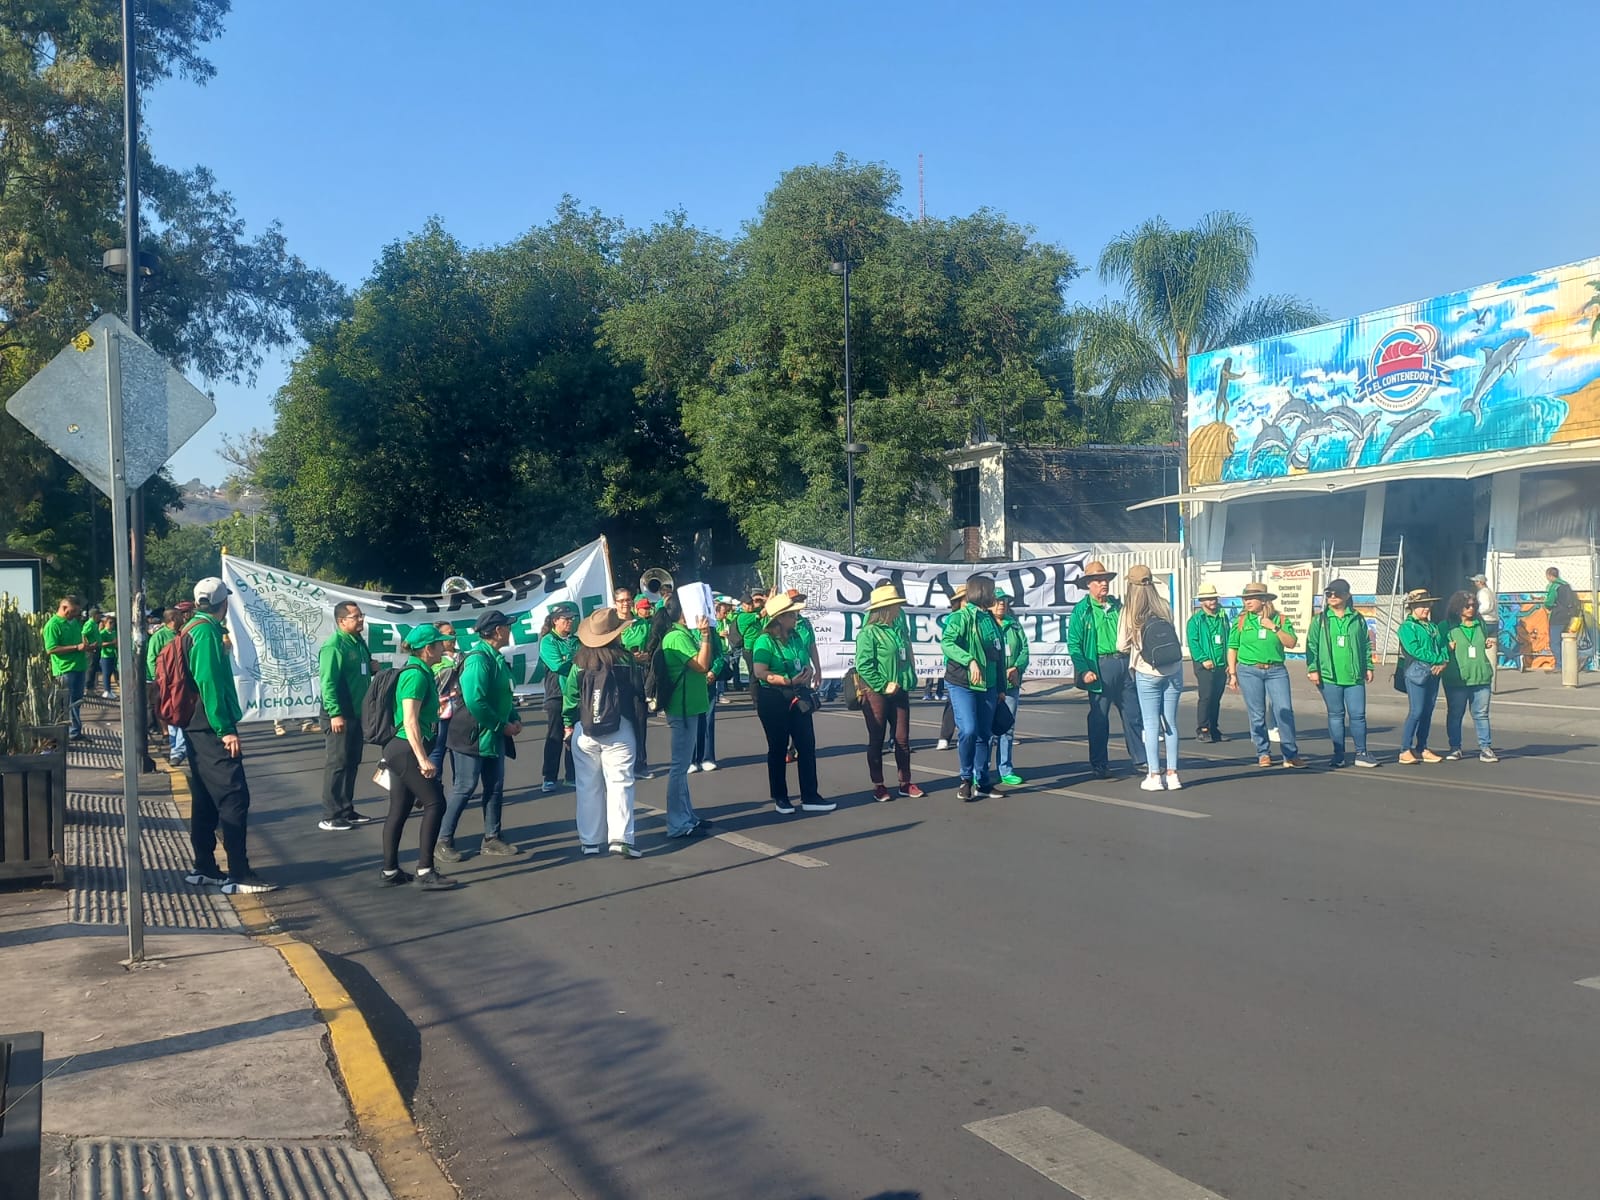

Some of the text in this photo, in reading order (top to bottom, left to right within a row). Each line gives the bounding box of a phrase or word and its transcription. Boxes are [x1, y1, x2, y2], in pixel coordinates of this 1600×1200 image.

[1372, 371, 1430, 391] EL CONTENEDOR
[781, 555, 837, 573] STASPE
[235, 572, 326, 601] STASPE
[252, 585, 277, 596] 2016
[381, 562, 568, 614] STASPE
[836, 561, 1085, 608] STAPE
[246, 694, 324, 710] MICHOACA
